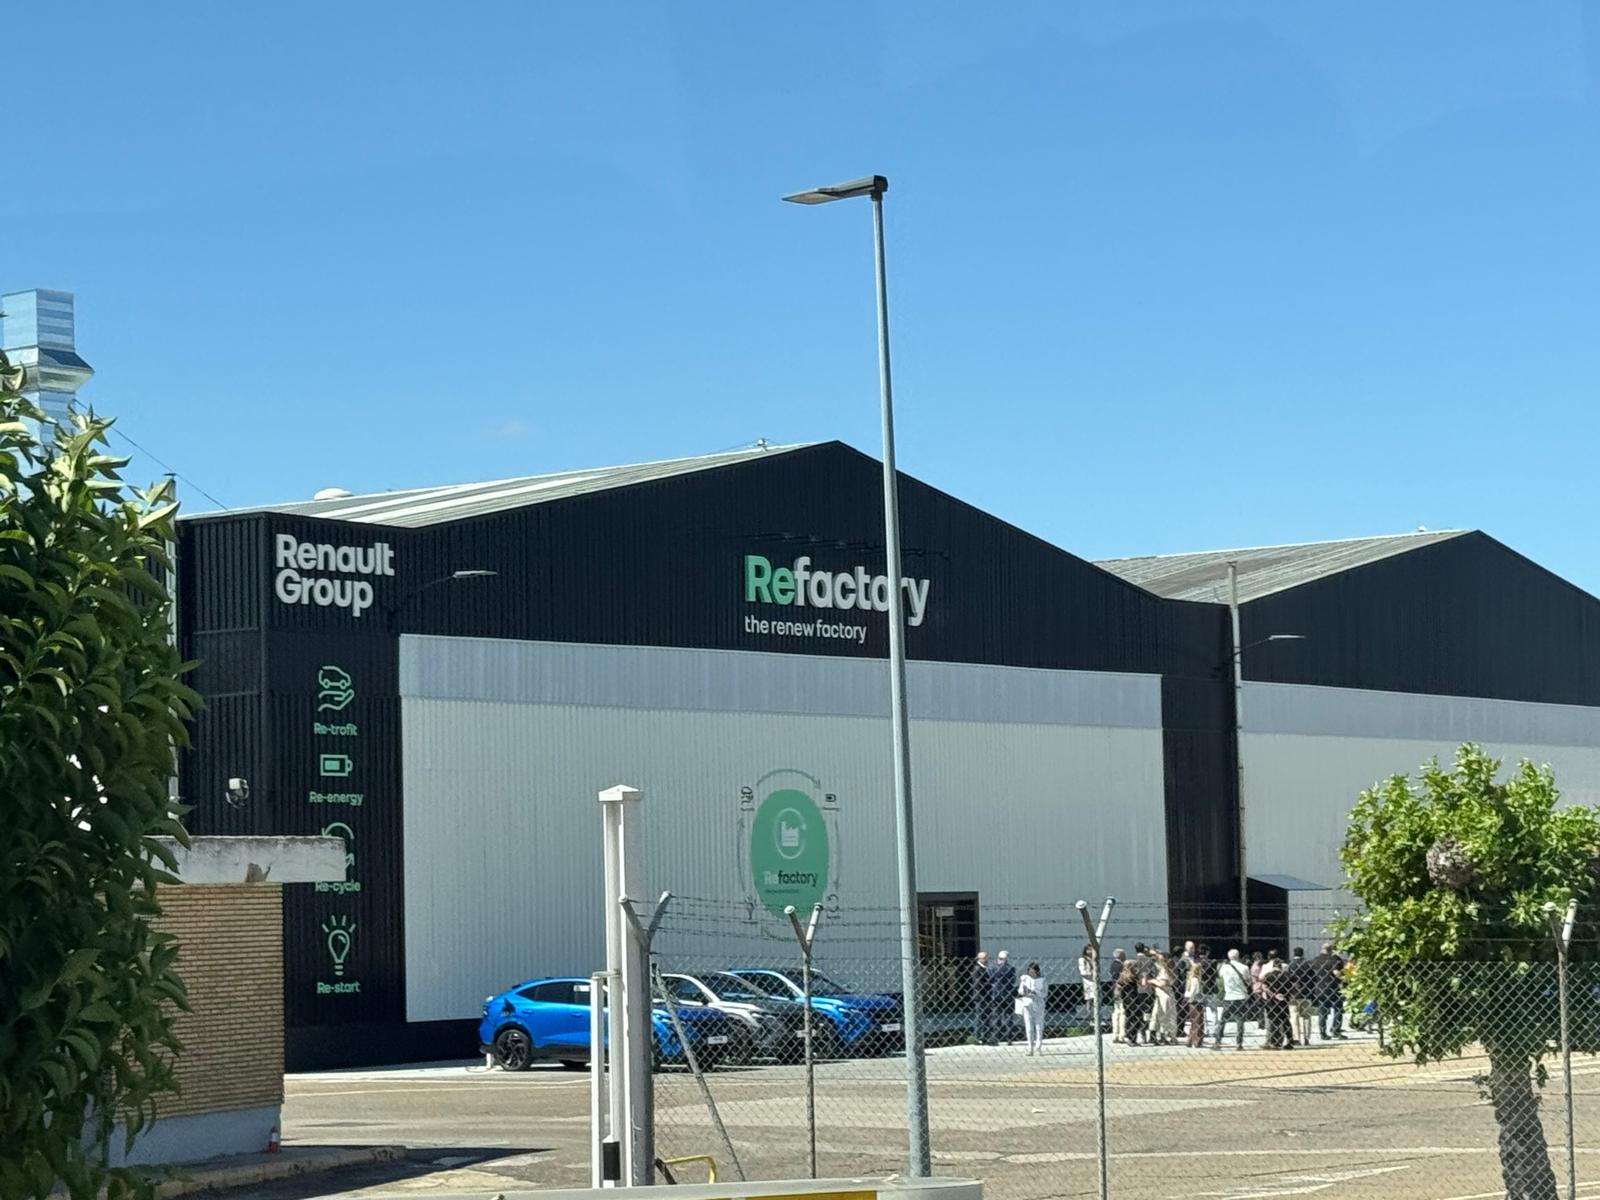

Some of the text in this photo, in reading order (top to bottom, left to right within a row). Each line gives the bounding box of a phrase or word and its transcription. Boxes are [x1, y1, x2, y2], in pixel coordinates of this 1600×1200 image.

[276, 533, 395, 576] Renault
[275, 568, 374, 617] Group
[744, 614, 867, 644] the renew factory
[309, 791, 364, 806] Re-energy
[316, 981, 361, 994] Re-start
